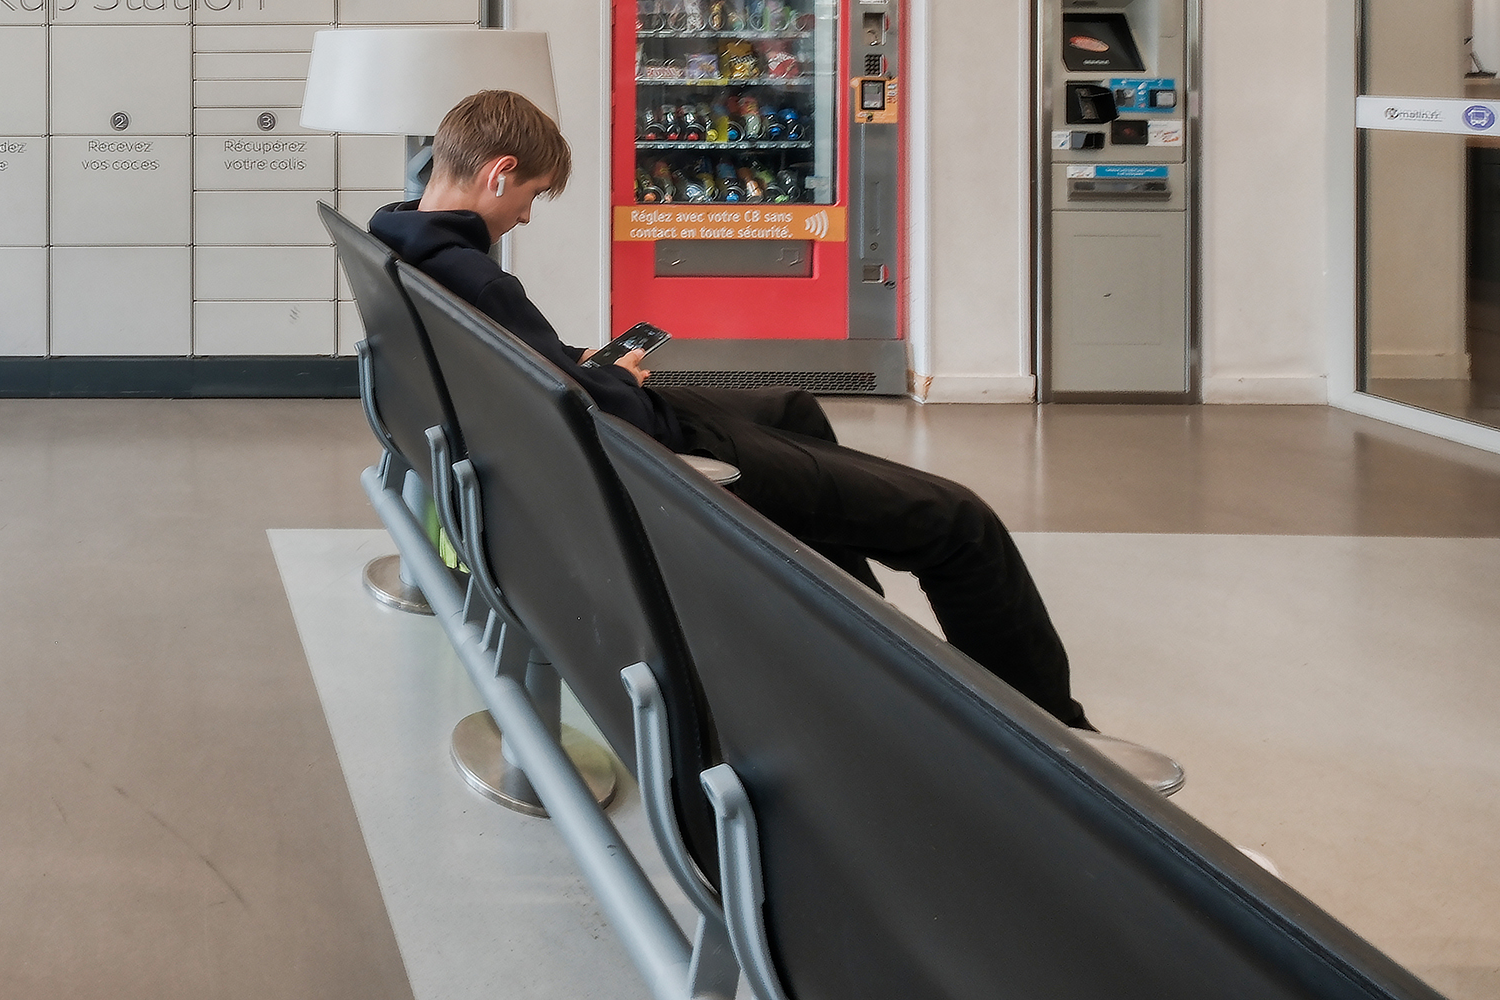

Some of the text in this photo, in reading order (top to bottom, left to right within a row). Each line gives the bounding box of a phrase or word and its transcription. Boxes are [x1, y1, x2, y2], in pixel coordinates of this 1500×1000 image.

[87, 139, 154, 153] Recevez
[223, 138, 308, 155] Récupérez
[81, 159, 111, 171] vos
[224, 157, 308, 171] votre colis
[630, 209, 793, 226] Réglez avec votre CB sans
[629, 224, 794, 239] contact en toute sécurité.
